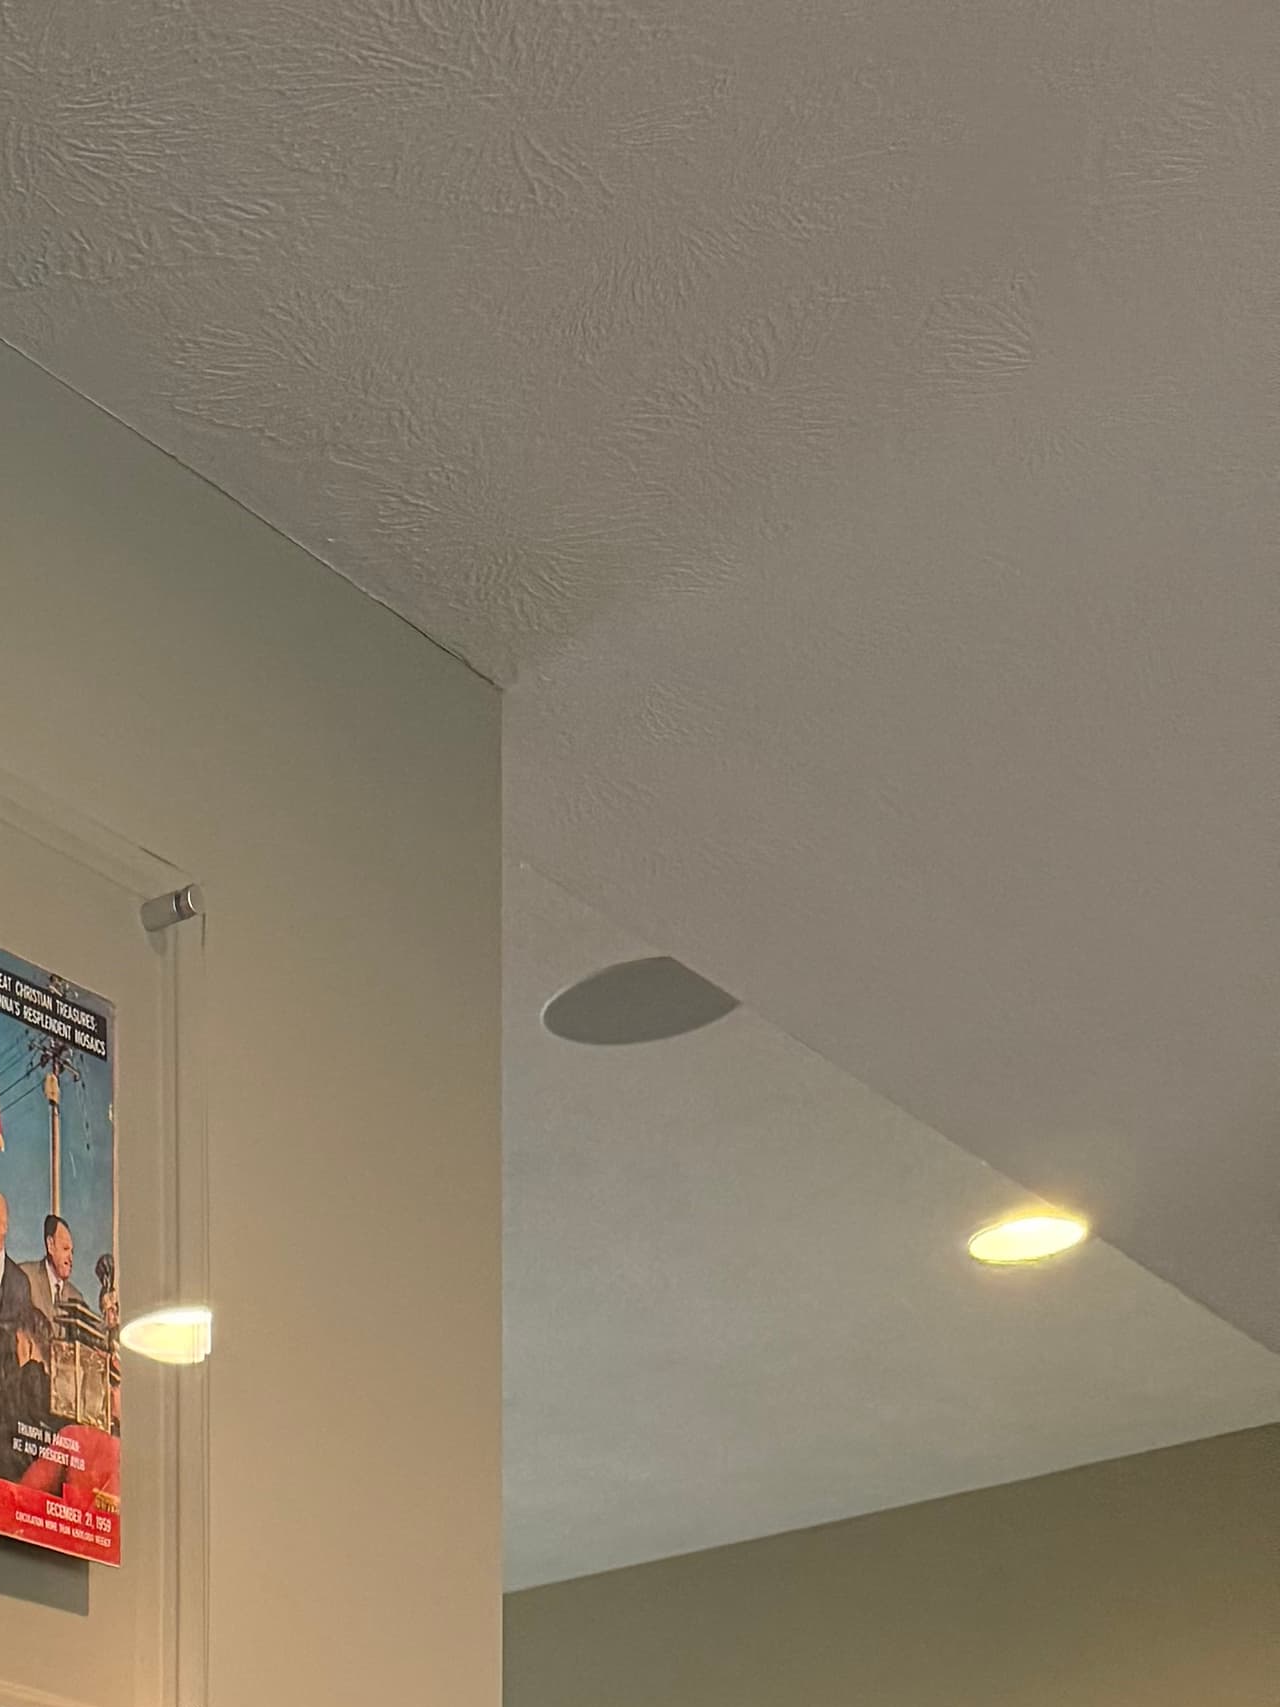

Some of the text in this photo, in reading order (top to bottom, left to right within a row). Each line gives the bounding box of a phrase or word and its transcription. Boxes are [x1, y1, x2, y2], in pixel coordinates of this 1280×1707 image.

[15, 981, 53, 1011] CHRISTIAN
[23, 1005, 71, 1040] RESPLENDENT
[75, 1029, 105, 1056] MOSAICS
[47, 1500, 81, 1524] DECEMBER
